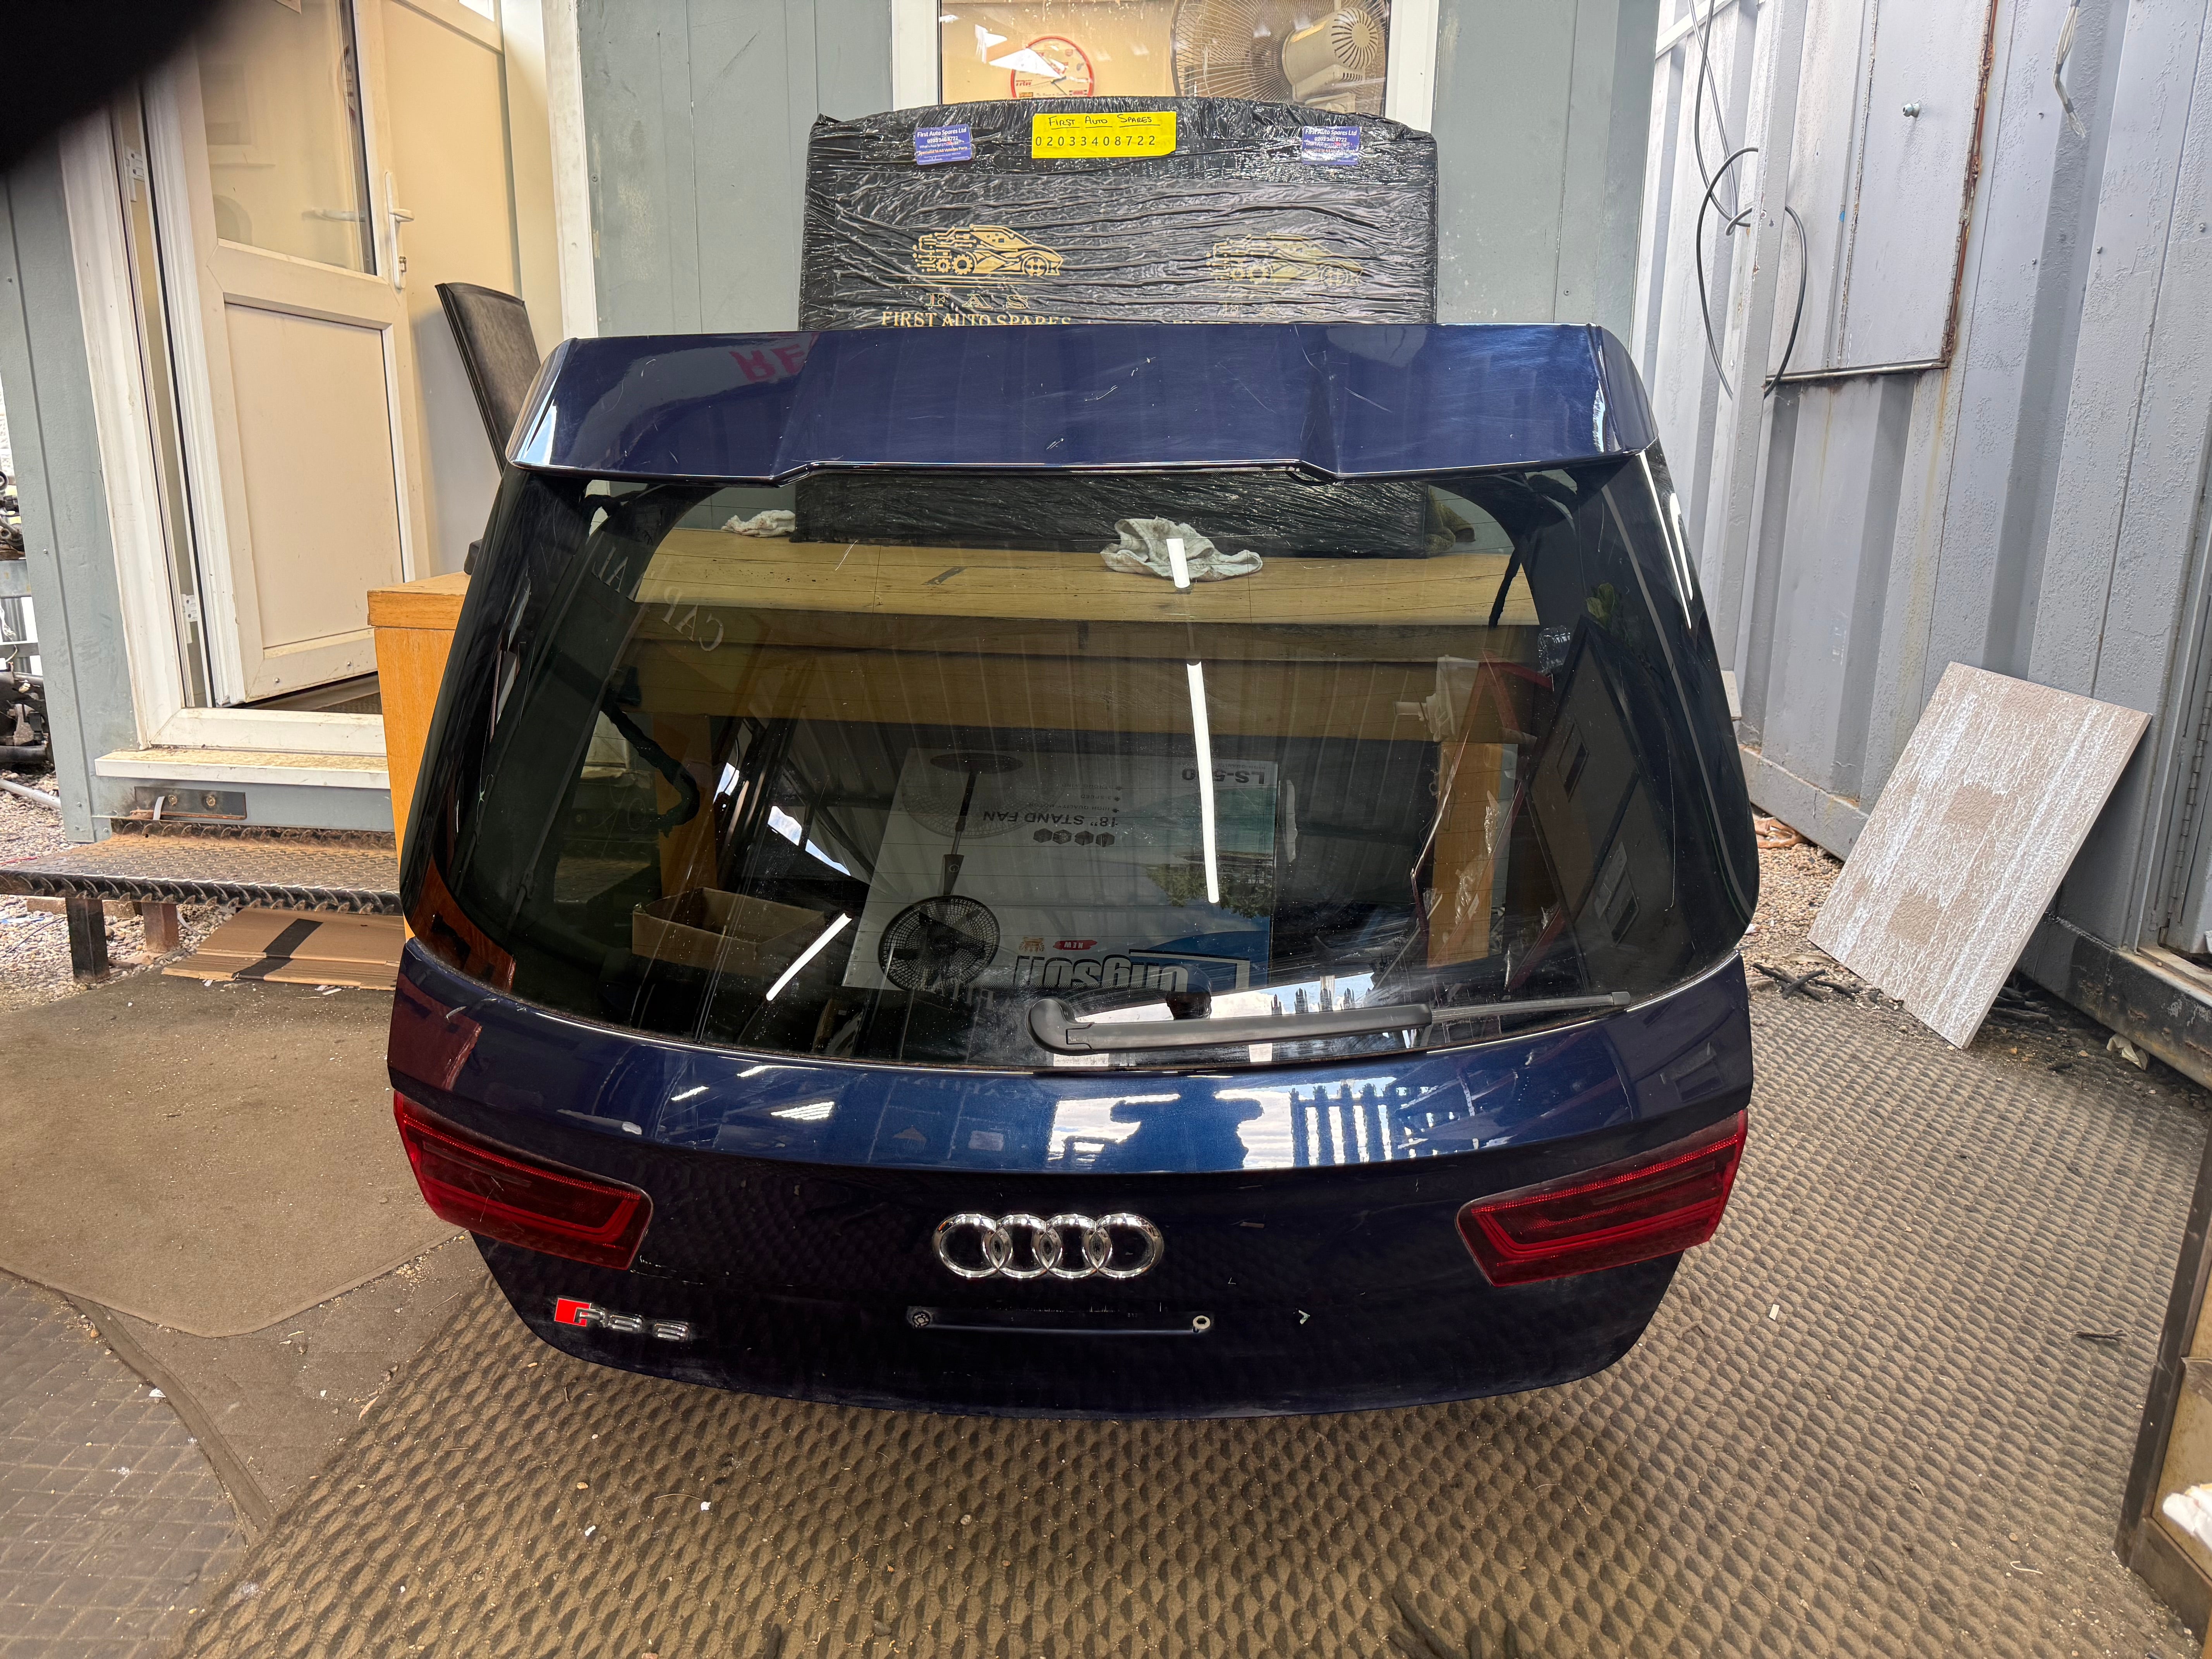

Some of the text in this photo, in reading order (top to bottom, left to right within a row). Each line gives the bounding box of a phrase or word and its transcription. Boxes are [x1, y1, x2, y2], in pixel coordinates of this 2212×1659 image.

[1049, 114, 1152, 127] FIRST AUTO SPARES
[1036, 136, 1156, 146] 02033408722
[881, 311, 938, 328] FIRST
[942, 313, 992, 327] AUTO
[1182, 768, 1265, 785] LS-50
[982, 811, 1019, 822] FAN
[1024, 812, 1085, 825] STAND
